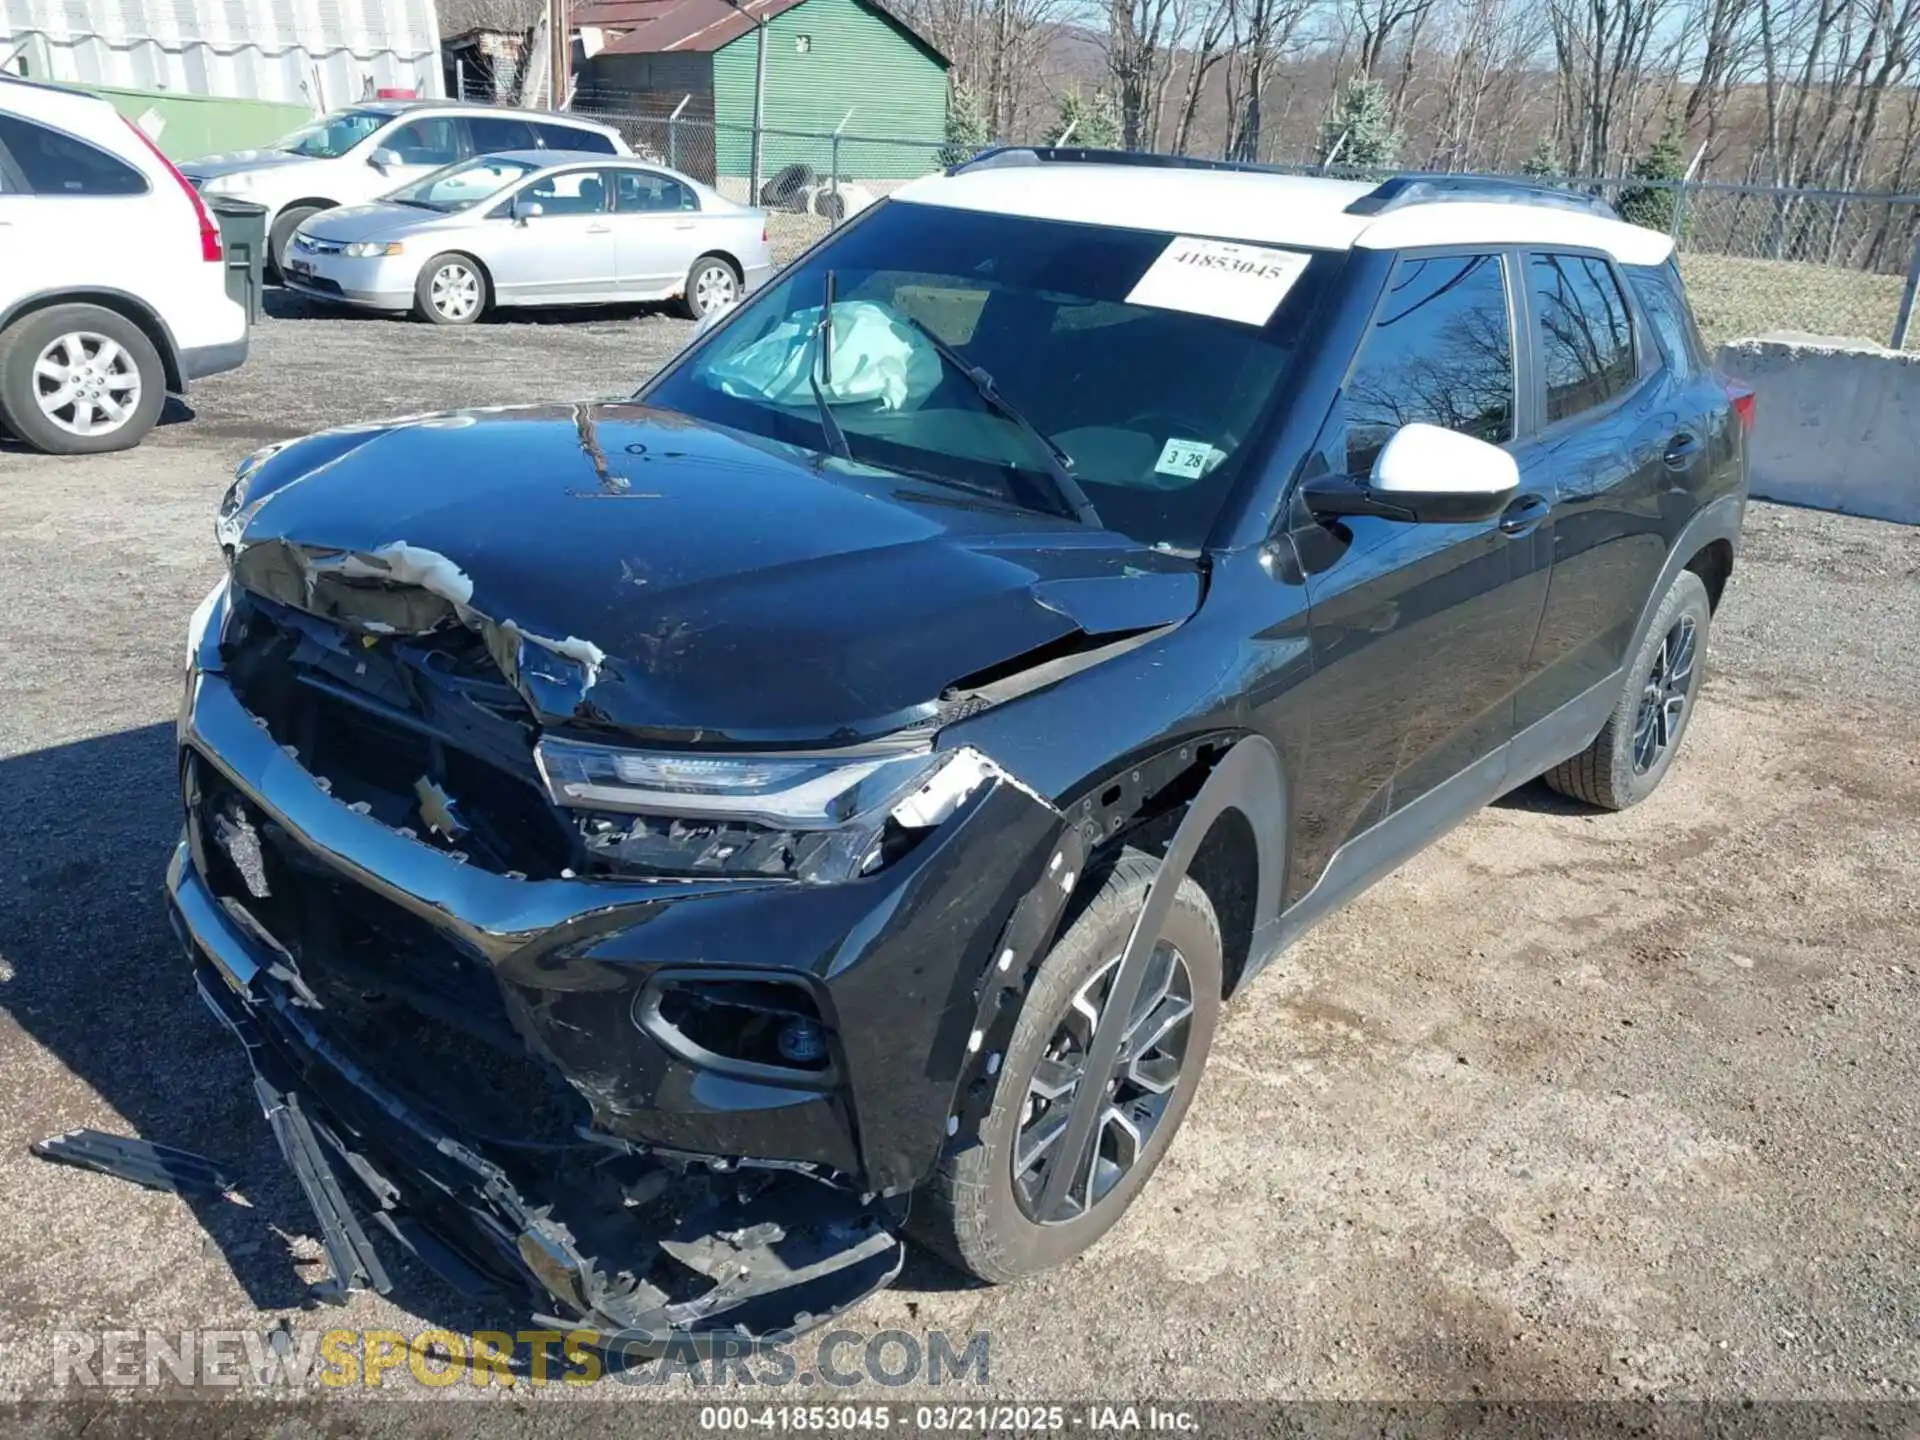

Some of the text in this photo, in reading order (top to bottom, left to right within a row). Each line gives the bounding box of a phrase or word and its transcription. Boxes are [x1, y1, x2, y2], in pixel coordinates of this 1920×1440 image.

[1174, 251, 1284, 280] 41853045
[1168, 450, 1204, 469] 3 28
